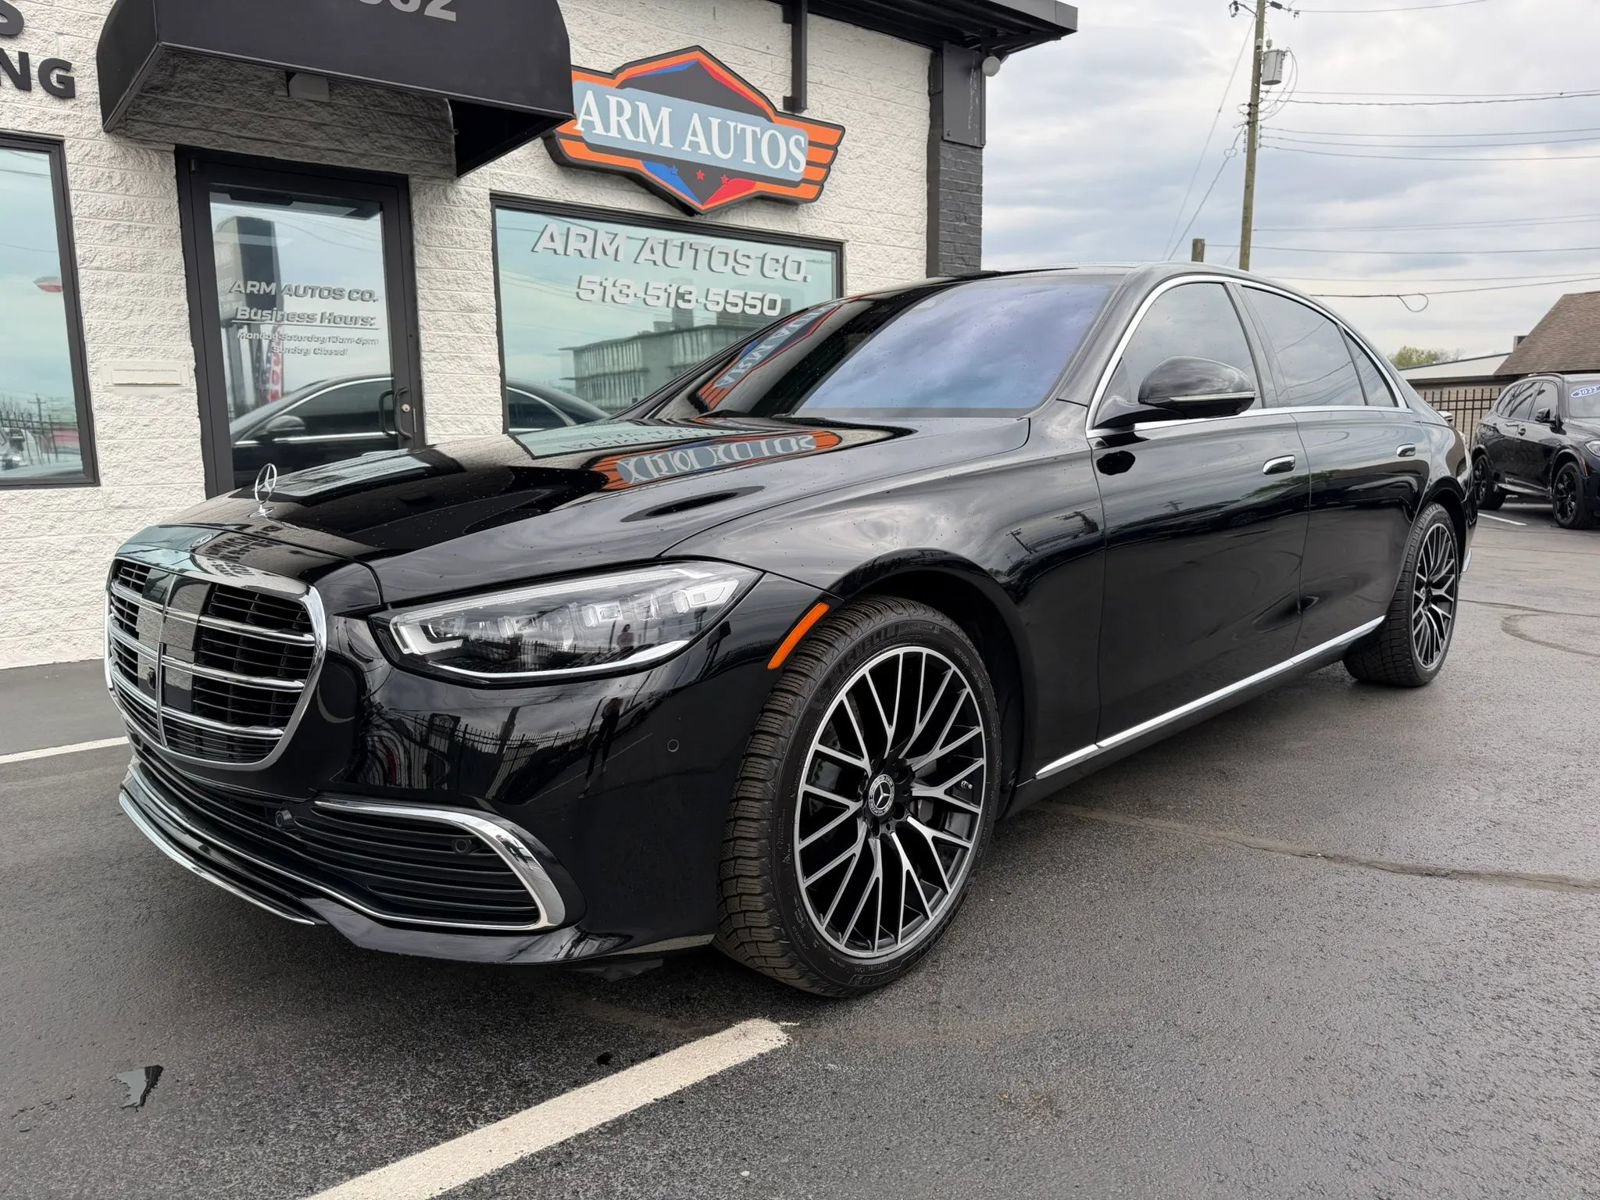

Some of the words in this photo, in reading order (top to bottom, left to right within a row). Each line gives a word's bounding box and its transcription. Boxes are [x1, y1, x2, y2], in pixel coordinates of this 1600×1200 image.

[573, 89, 673, 149] ARM
[681, 112, 807, 174] AUTOS
[531, 223, 627, 262] ARM
[634, 236, 753, 276] AUTOS
[758, 254, 812, 284] CO.
[229, 280, 277, 296] ARM
[281, 284, 347, 301] AUTOS
[347, 288, 379, 303] CO.
[576, 274, 783, 317] 513-513-5550
[236, 306, 318, 324] Business
[319, 311, 377, 327] Hours:
